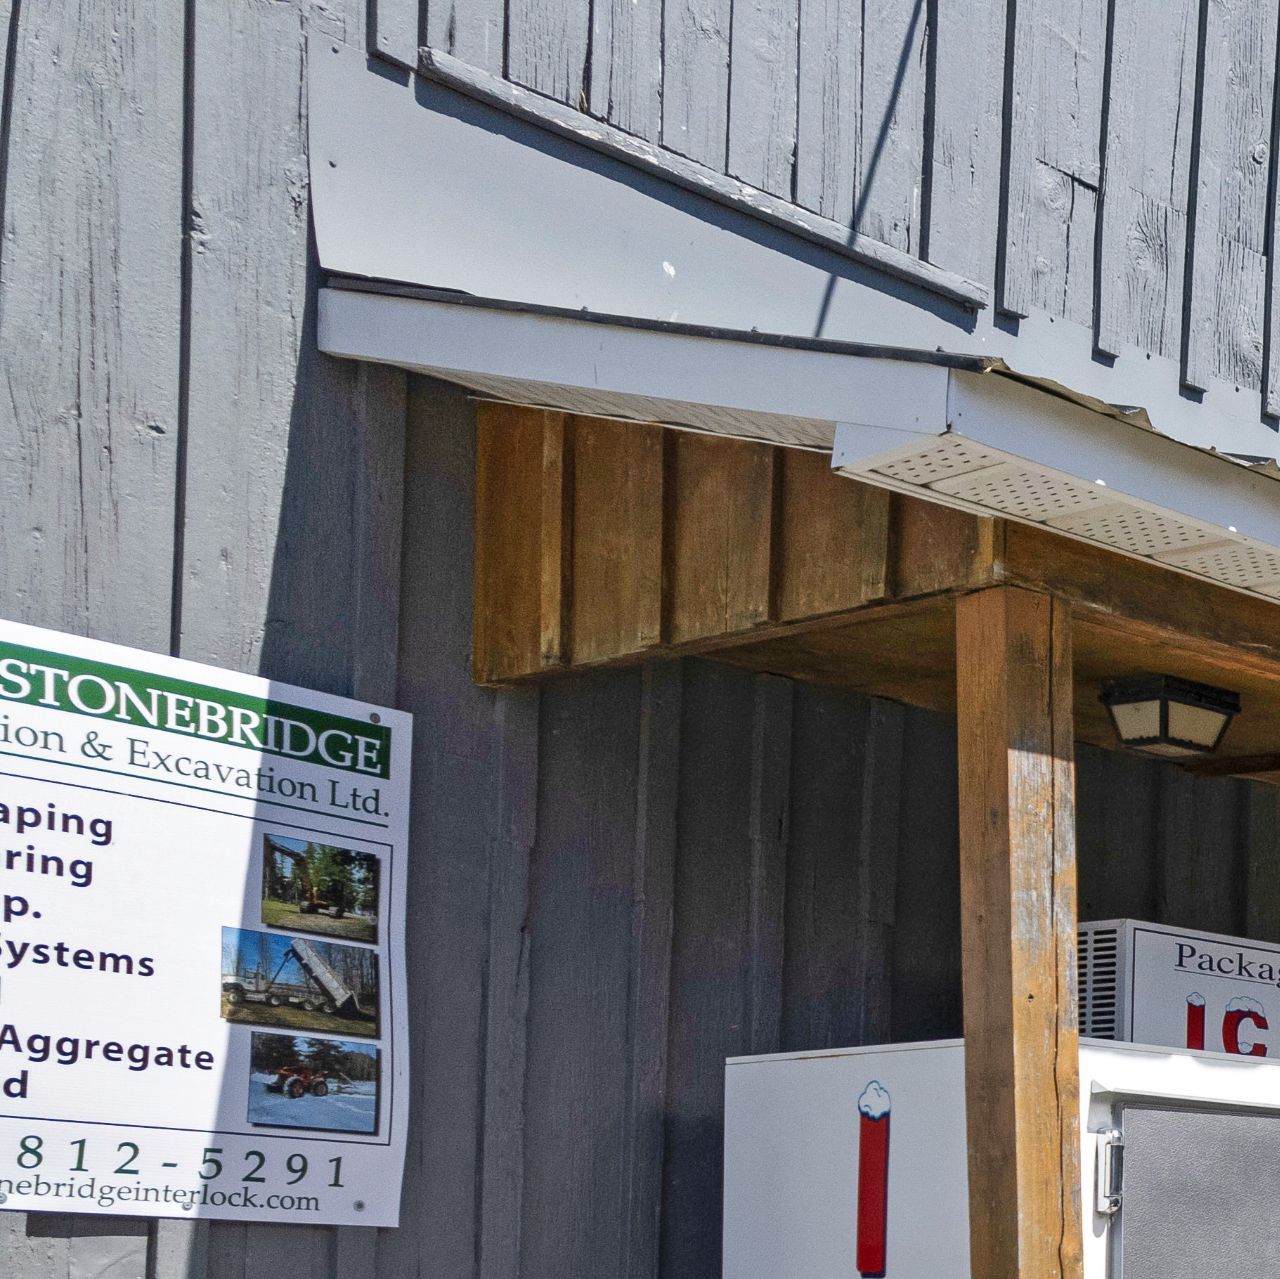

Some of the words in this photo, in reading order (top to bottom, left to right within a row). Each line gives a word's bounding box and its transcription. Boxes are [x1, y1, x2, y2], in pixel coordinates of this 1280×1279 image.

[0, 658, 382, 774] STONEBRIDGE
[80, 730, 113, 762] &
[126, 736, 319, 804] Excavation
[327, 778, 390, 818] Ltd.
[0, 932, 155, 977] ystems
[0, 1023, 215, 1072] Aggregate
